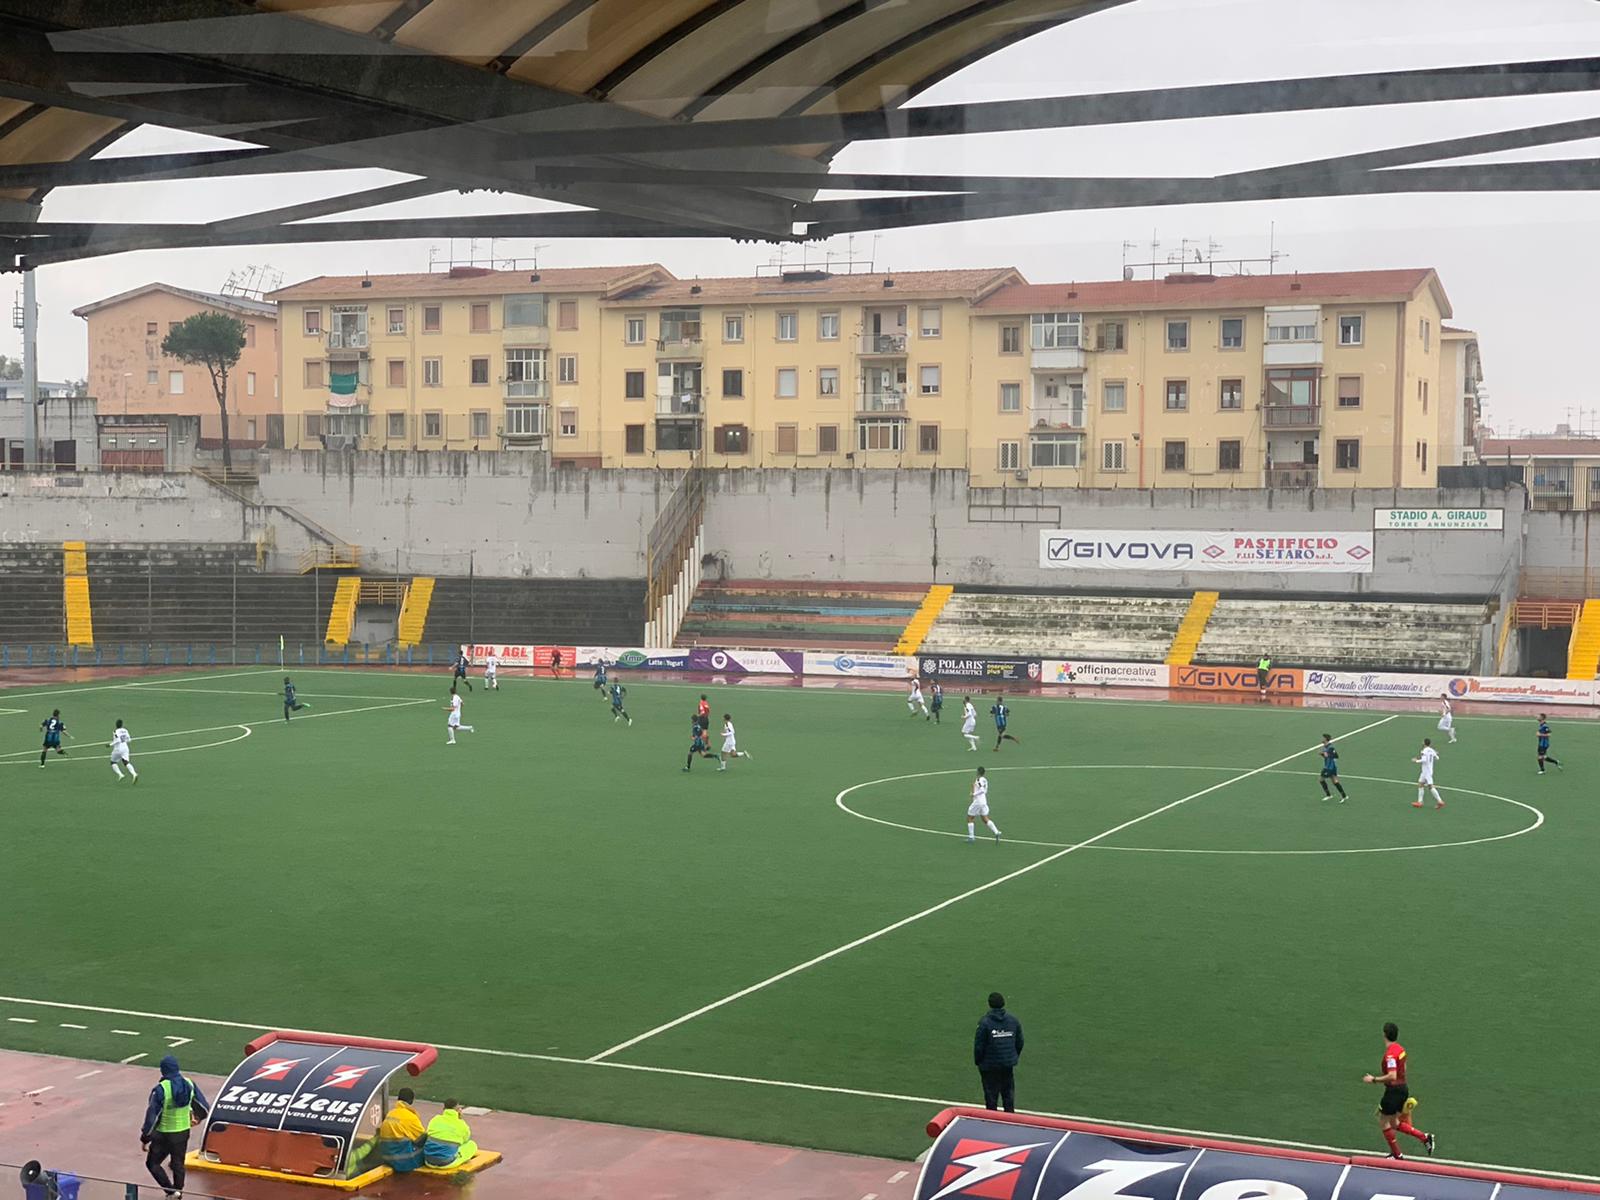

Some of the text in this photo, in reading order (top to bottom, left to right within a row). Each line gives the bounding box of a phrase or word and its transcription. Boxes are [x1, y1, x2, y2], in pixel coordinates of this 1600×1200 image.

[1390, 511, 1487, 520] STADIO A. GIRAUD
[1234, 538, 1338, 549] PASTIFICIO
[1073, 542, 1194, 559] GIVOVA
[1255, 549, 1315, 560] SETARO
[939, 659, 983, 670] POLARIS
[1077, 664, 1157, 676] officinacreativa
[49, 719, 57, 730] 2
[220, 1086, 292, 1108] Zeus
[216, 1103, 248, 1112] veste
[250, 1106, 266, 1114] gli
[289, 1093, 364, 1116] Zeus
[287, 1110, 318, 1120] veste
[320, 1114, 336, 1122] gli
